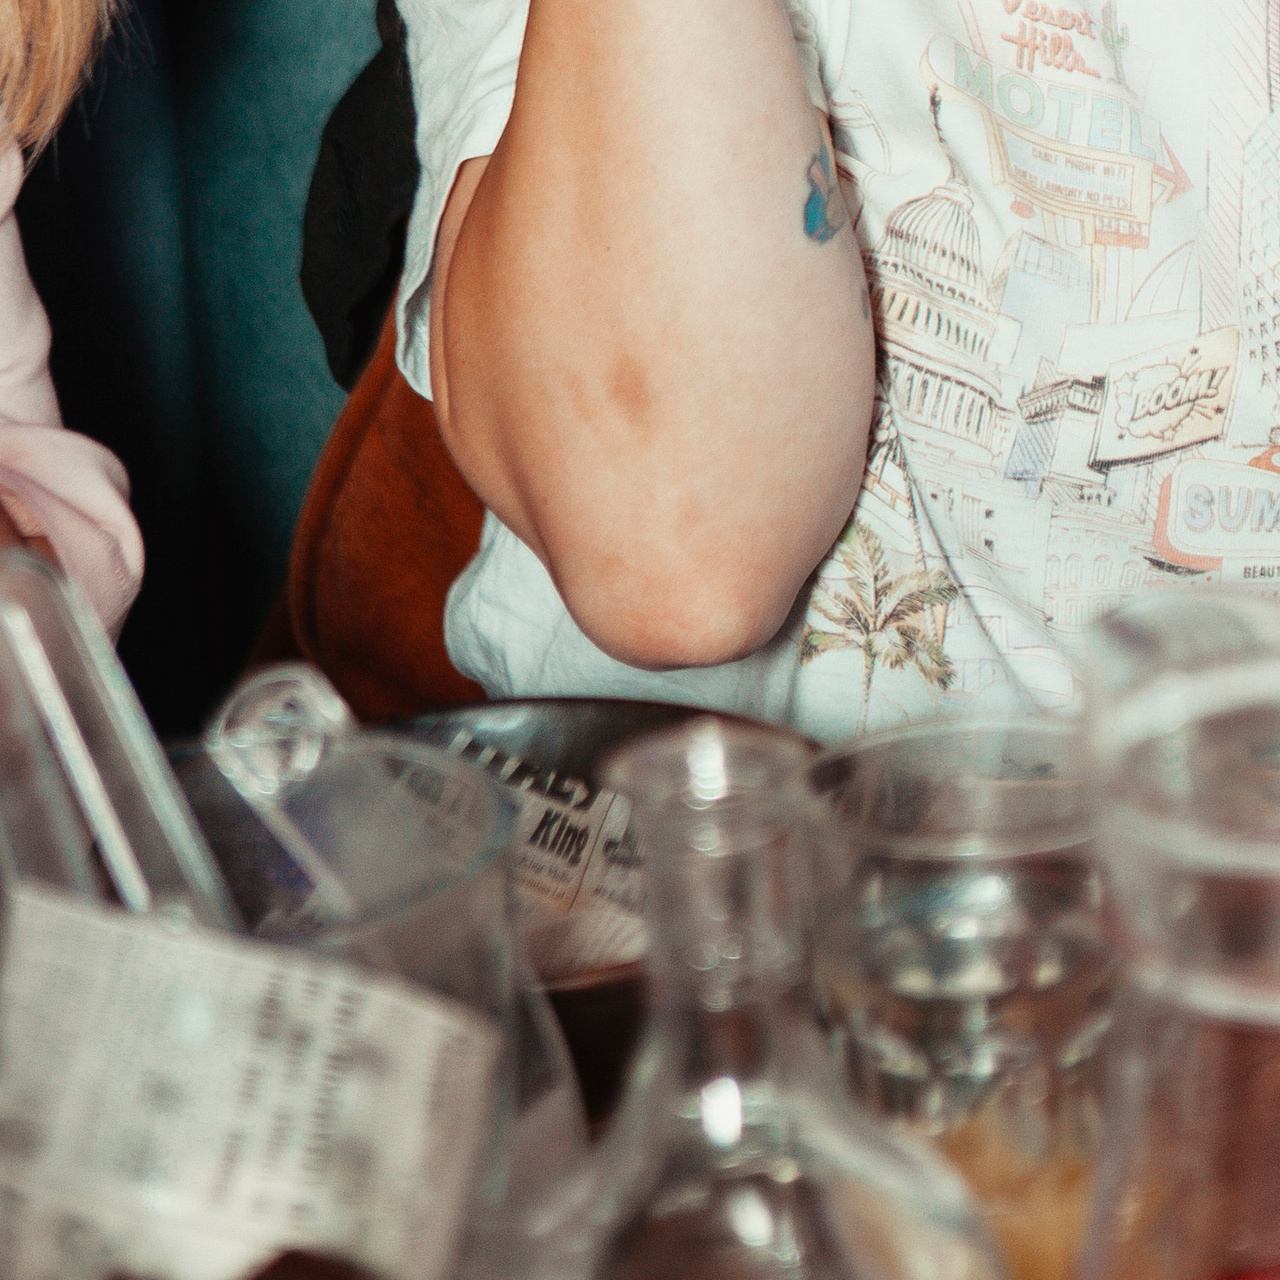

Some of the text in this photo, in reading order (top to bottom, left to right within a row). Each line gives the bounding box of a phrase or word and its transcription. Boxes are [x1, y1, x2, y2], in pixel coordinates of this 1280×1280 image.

[1001, 20, 1101, 79] Hills
[953, 40, 1158, 162] MOTEL
[1102, 192, 1129, 209] PETS
[1130, 365, 1231, 422] BOOM!
